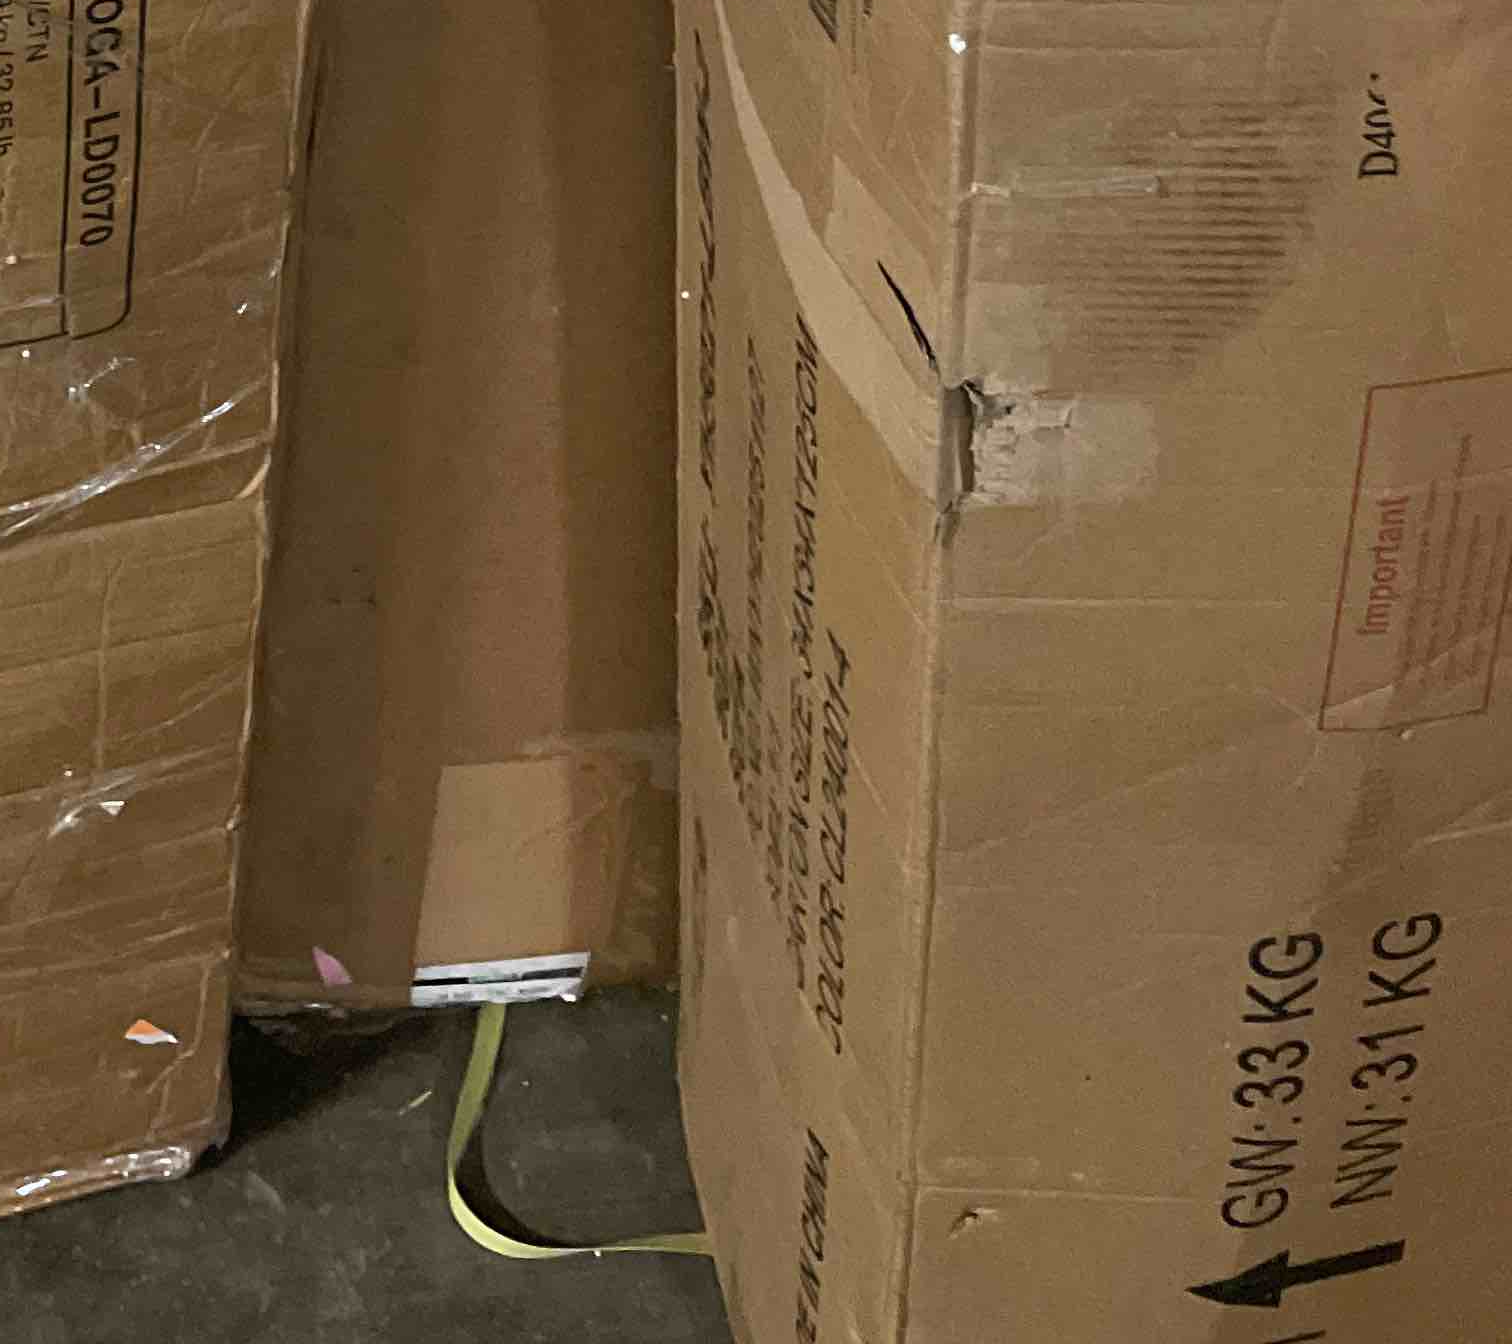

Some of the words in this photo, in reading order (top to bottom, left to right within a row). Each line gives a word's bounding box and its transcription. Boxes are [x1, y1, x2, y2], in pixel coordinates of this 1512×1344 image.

[1356, 495, 1411, 636] Important
[1241, 931, 1325, 1024] KG
[1361, 912, 1443, 1008] KG
